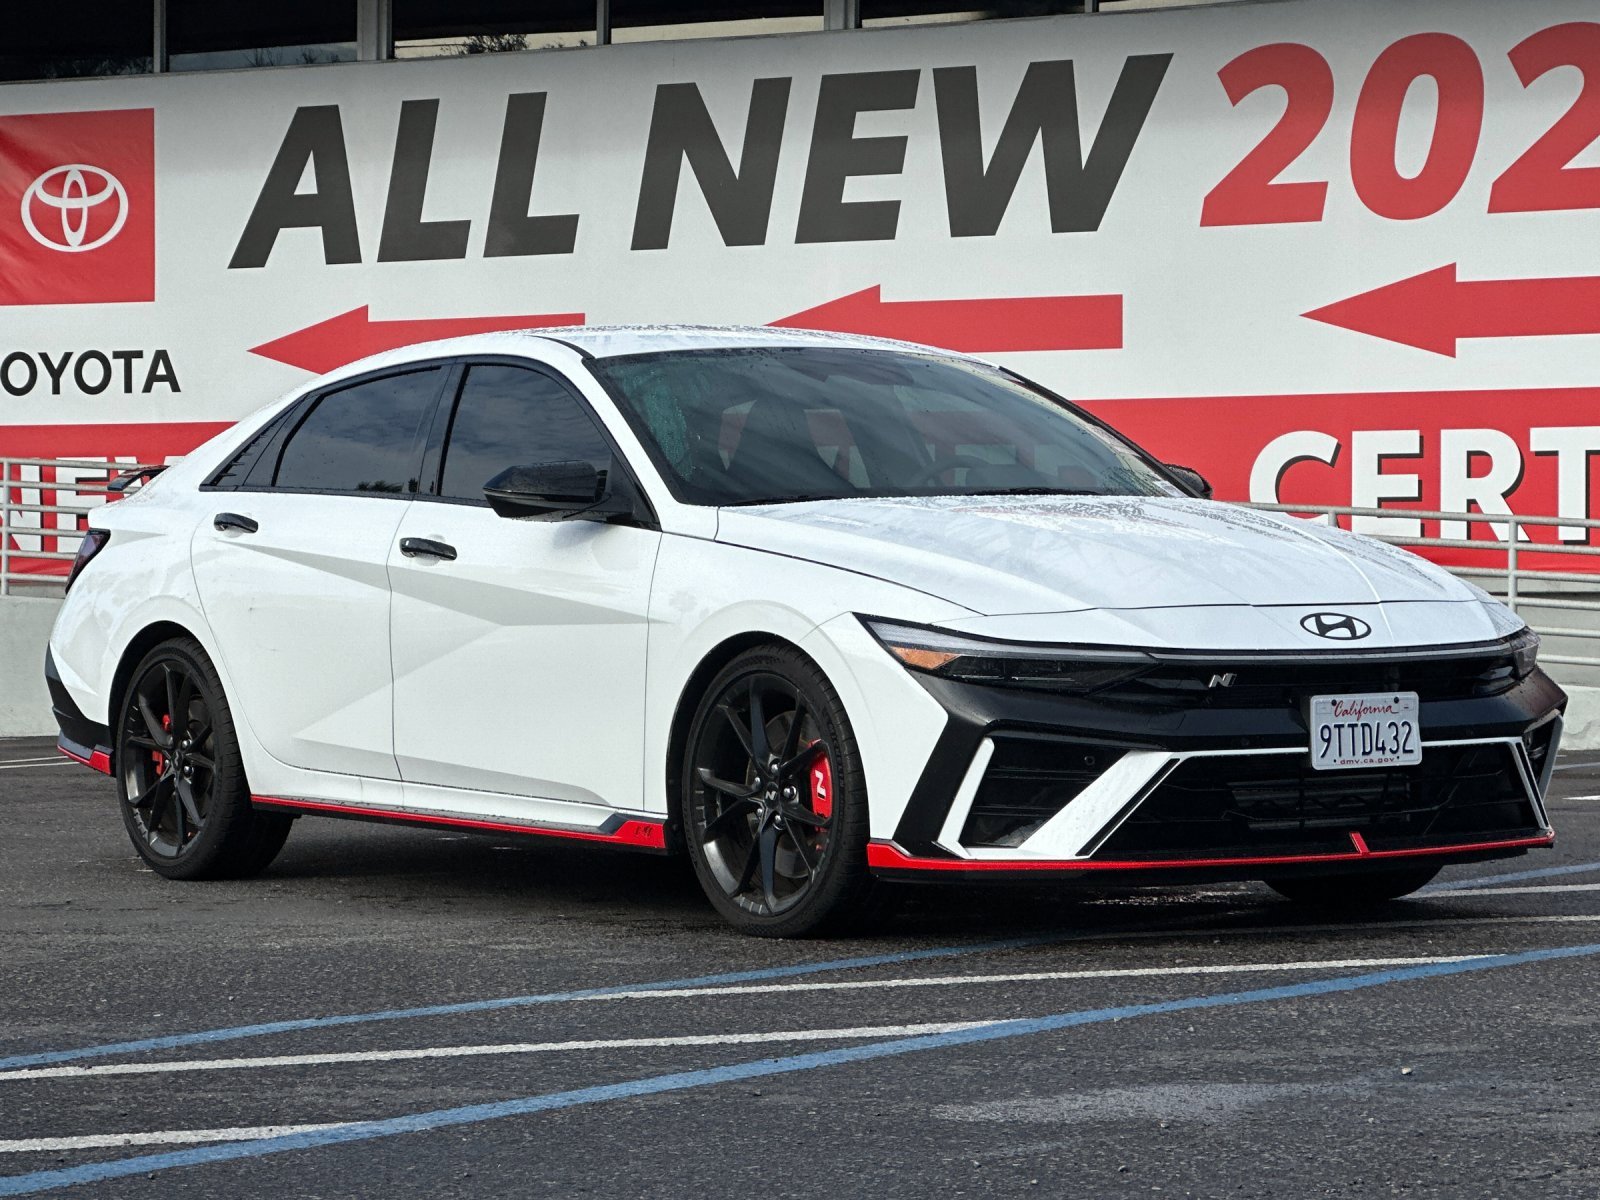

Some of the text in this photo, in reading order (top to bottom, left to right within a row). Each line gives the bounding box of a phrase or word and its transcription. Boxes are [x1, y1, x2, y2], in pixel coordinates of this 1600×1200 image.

[228, 91, 580, 269] ALL
[630, 53, 1174, 251] NEW
[1333, 700, 1399, 720] California
[1319, 721, 1414, 758] 9TTD432
[1340, 757, 1395, 765] dmv.ca.gov
